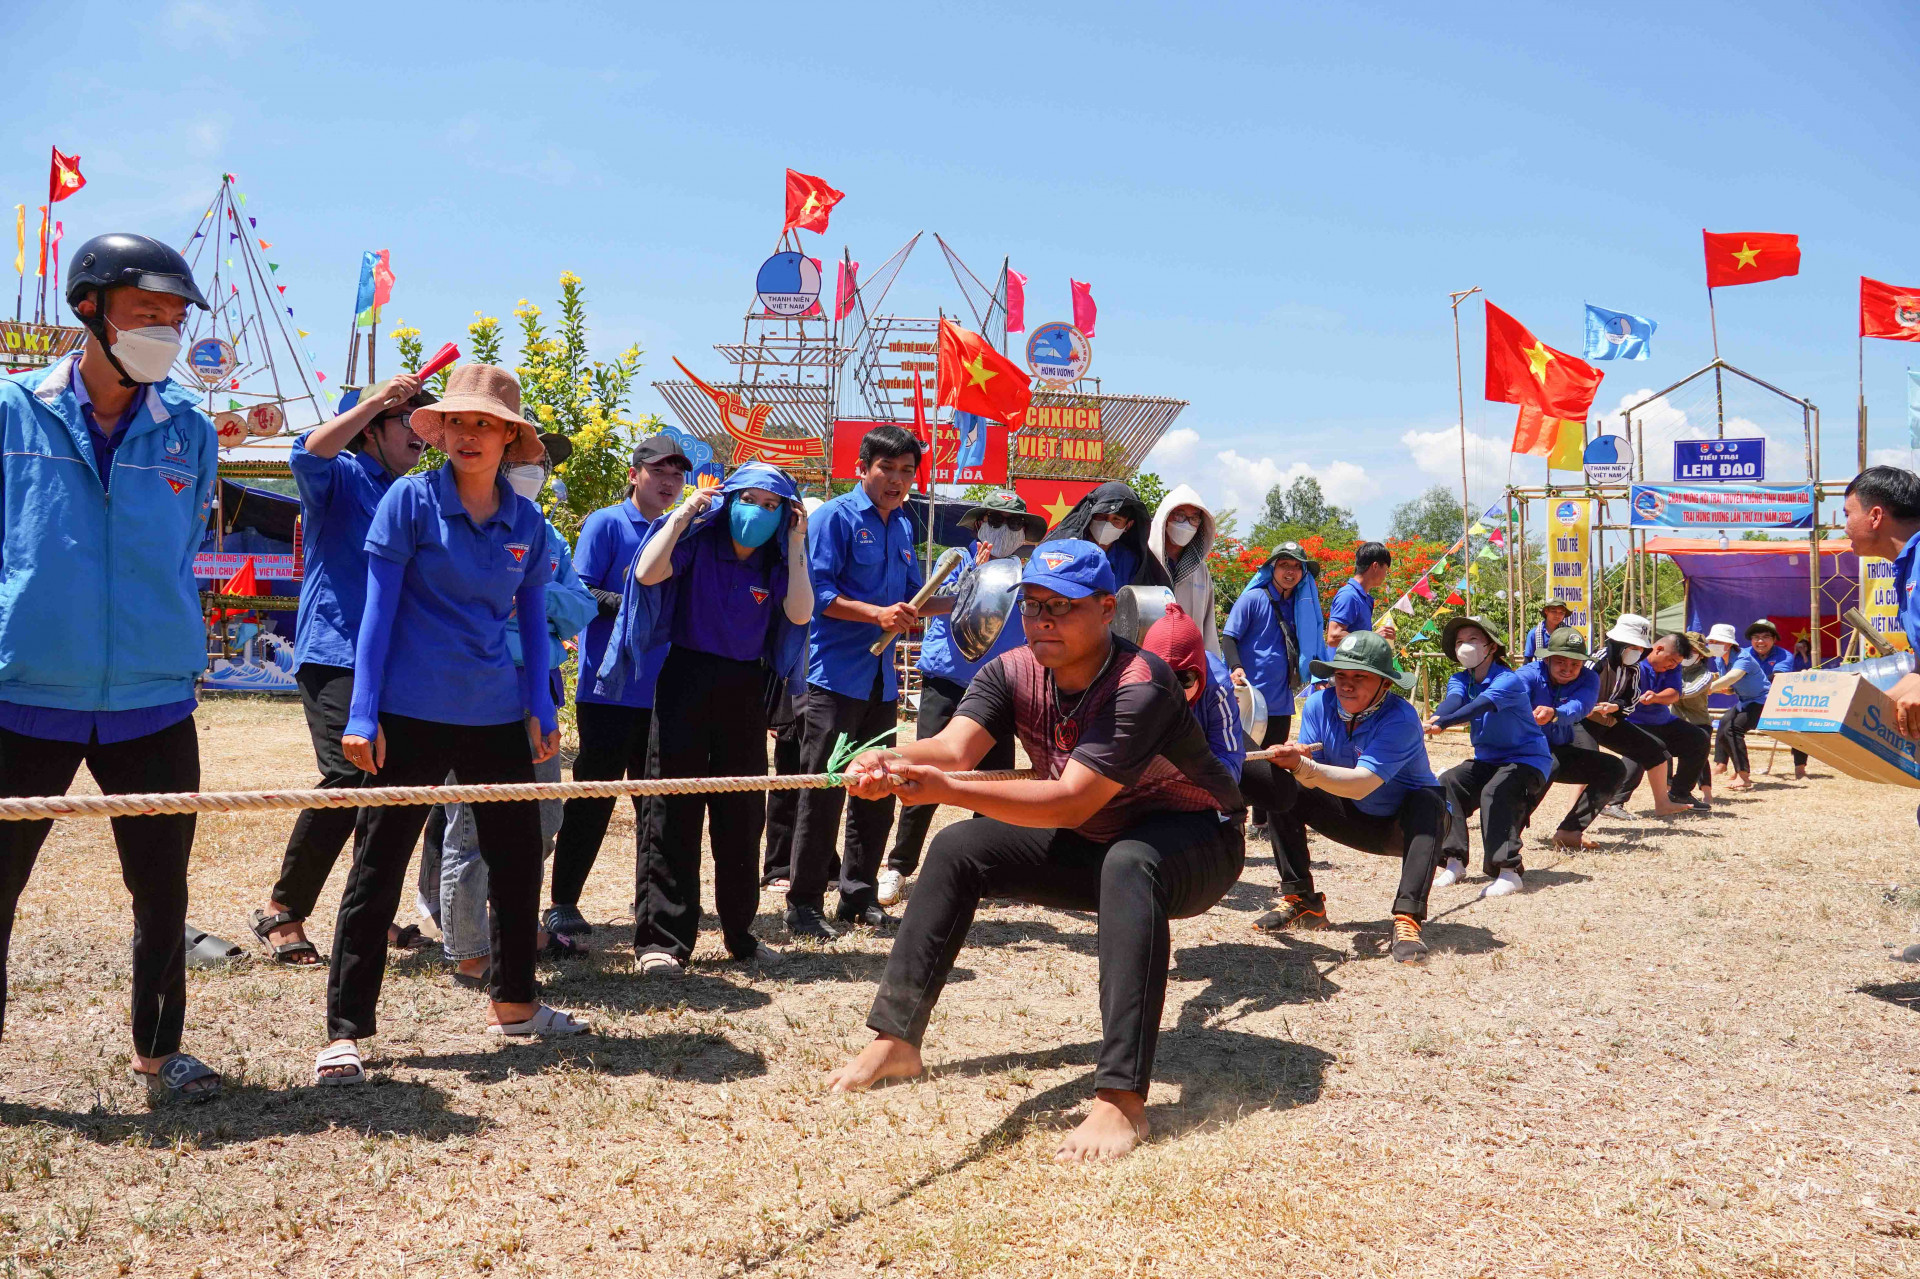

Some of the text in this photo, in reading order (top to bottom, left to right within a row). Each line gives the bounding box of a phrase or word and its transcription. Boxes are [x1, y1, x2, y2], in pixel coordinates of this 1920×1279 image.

[772, 302, 787, 310] VIỆT
[793, 295, 810, 303] NIÊN
[1025, 406, 1100, 429] CHXHCN
[1017, 434, 1102, 461] VIỆT NAM
[1682, 462, 1755, 477] LEN ĐAO
[1778, 512, 1792, 523] 2023
[275, 568, 293, 577] NAM
[1778, 685, 1830, 707] Sanna
[1862, 704, 1916, 757] Sanna
